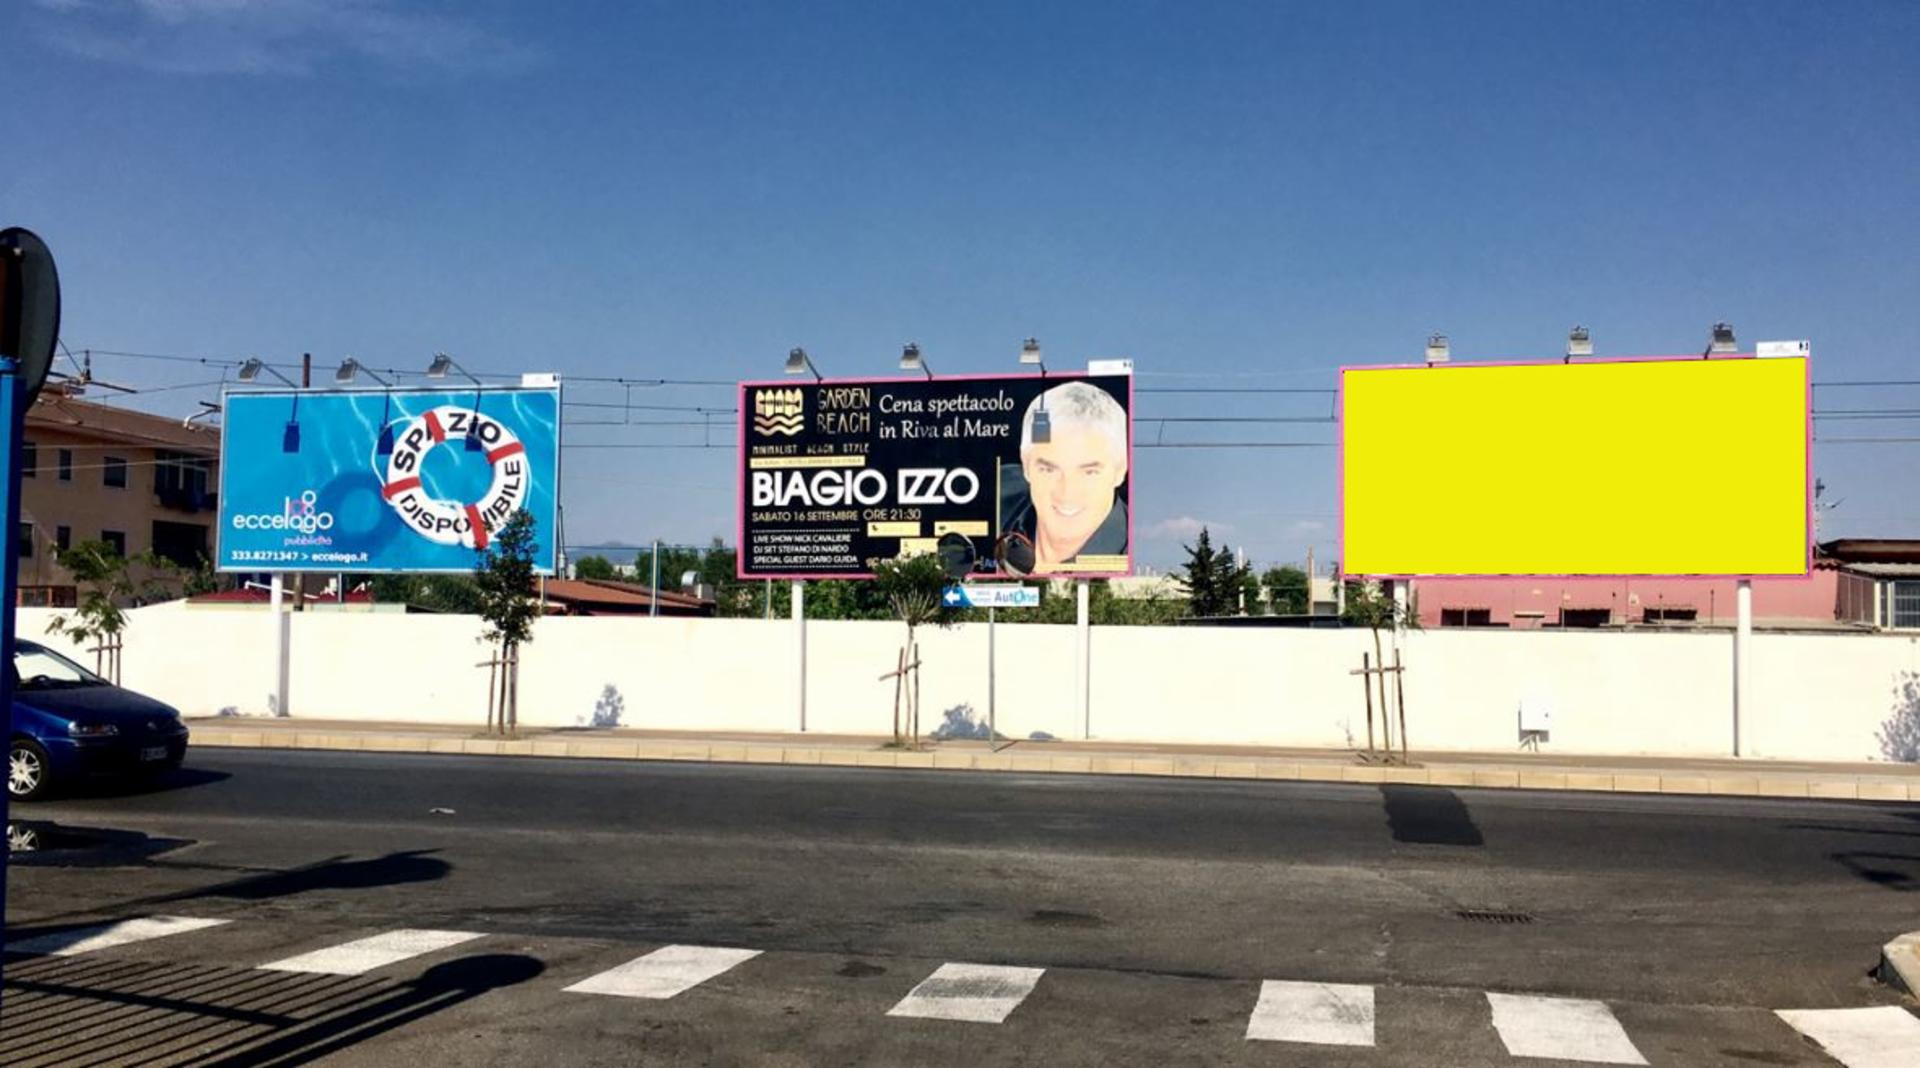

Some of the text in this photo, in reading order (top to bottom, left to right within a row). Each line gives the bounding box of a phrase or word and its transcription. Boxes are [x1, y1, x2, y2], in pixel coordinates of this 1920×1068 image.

[817, 388, 871, 410] GARDEN
[879, 390, 1014, 418] Cena spettacolo
[817, 412, 871, 434] BEACH
[879, 416, 1010, 439] in Riva al Mare
[752, 467, 980, 507] BIAGIO IZZO
[752, 508, 922, 522] SABATO 16 SETTEMBRE ORE 21:30
[753, 533, 852, 543] LIVE SHOW NICK CAVALIERE
[753, 545, 763, 554] DJ
[764, 545, 777, 554] SET
[778, 544, 812, 554] STEFANO
[821, 544, 850, 553] NARDO
[753, 556, 782, 564] SPECIAL
[783, 555, 808, 564] GUEST
